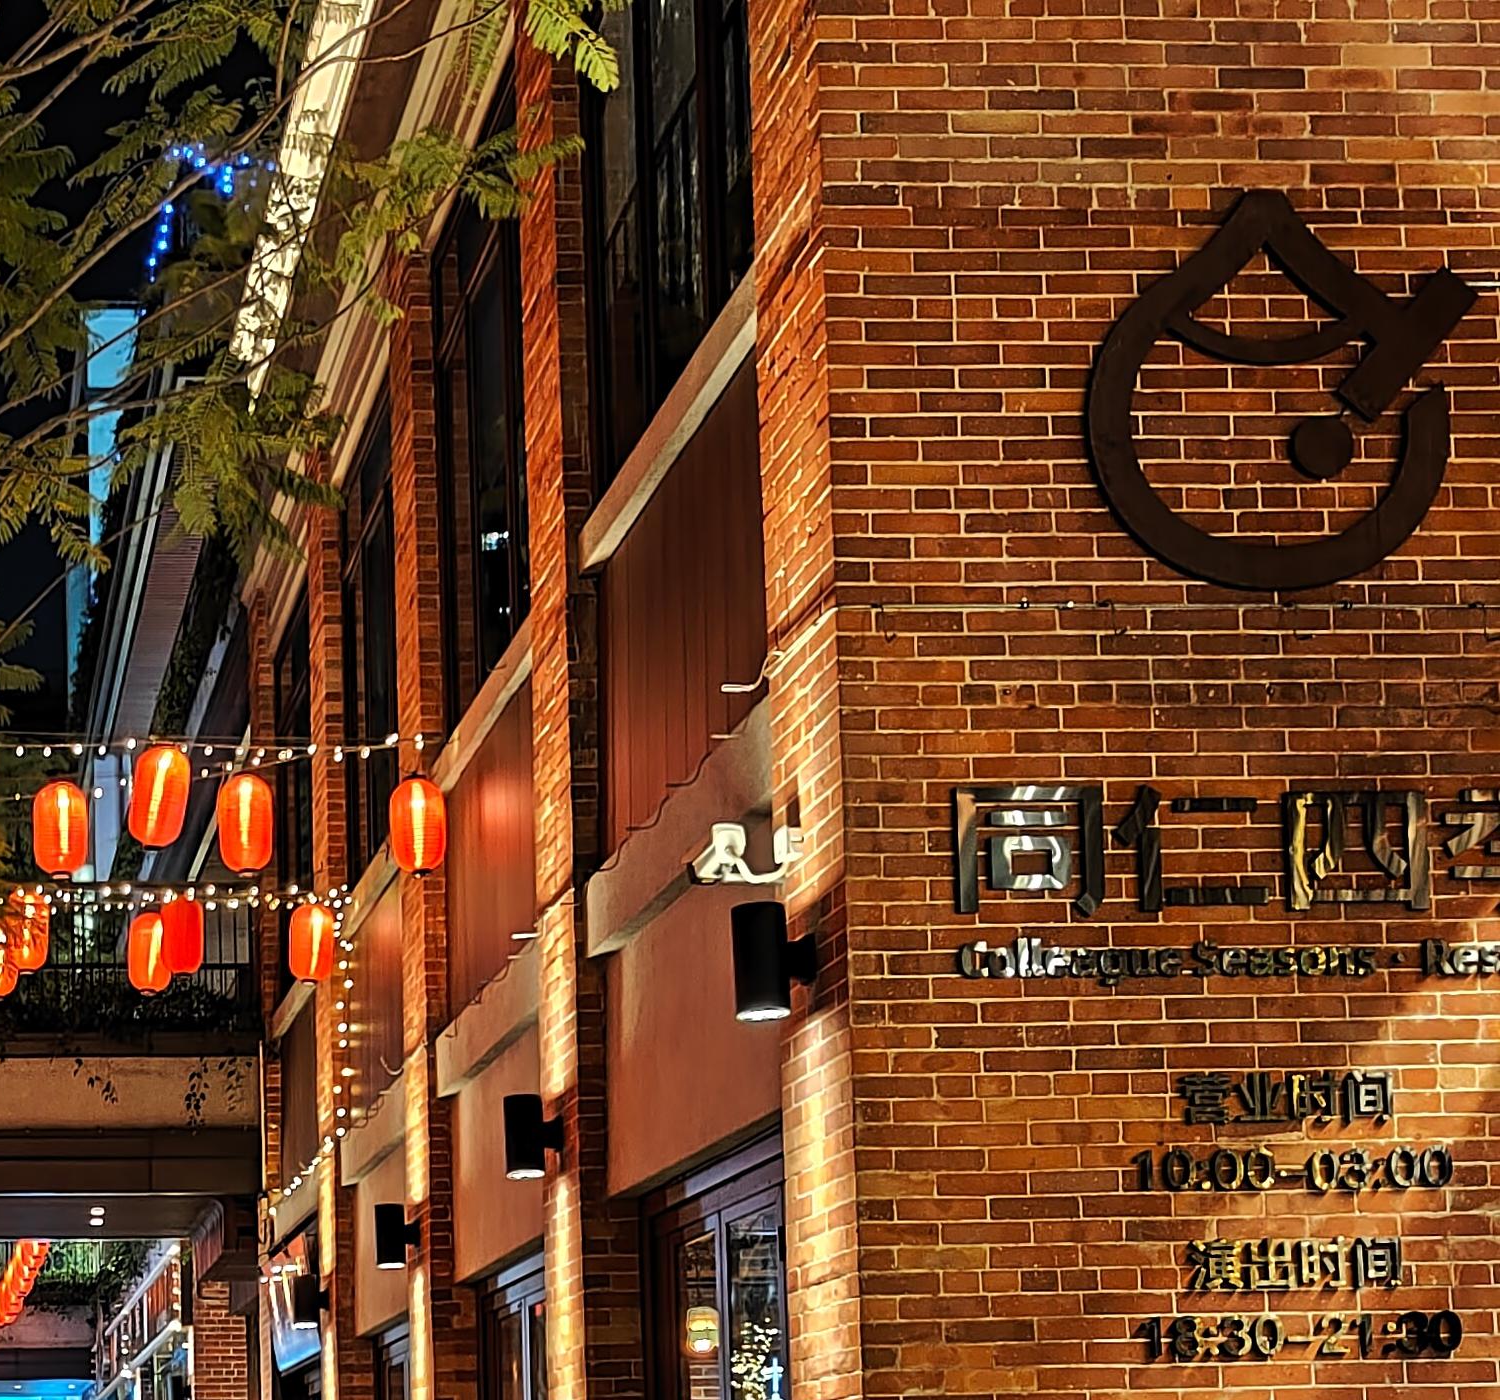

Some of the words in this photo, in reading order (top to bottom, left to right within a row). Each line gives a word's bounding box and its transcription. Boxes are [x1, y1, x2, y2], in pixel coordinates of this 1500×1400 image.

[959, 937, 1182, 986] Colleague
[1192, 939, 1377, 977] Seasons
[1178, 1071, 1394, 1124] 营业时间
[1187, 1236, 1403, 1289] 演出时间
